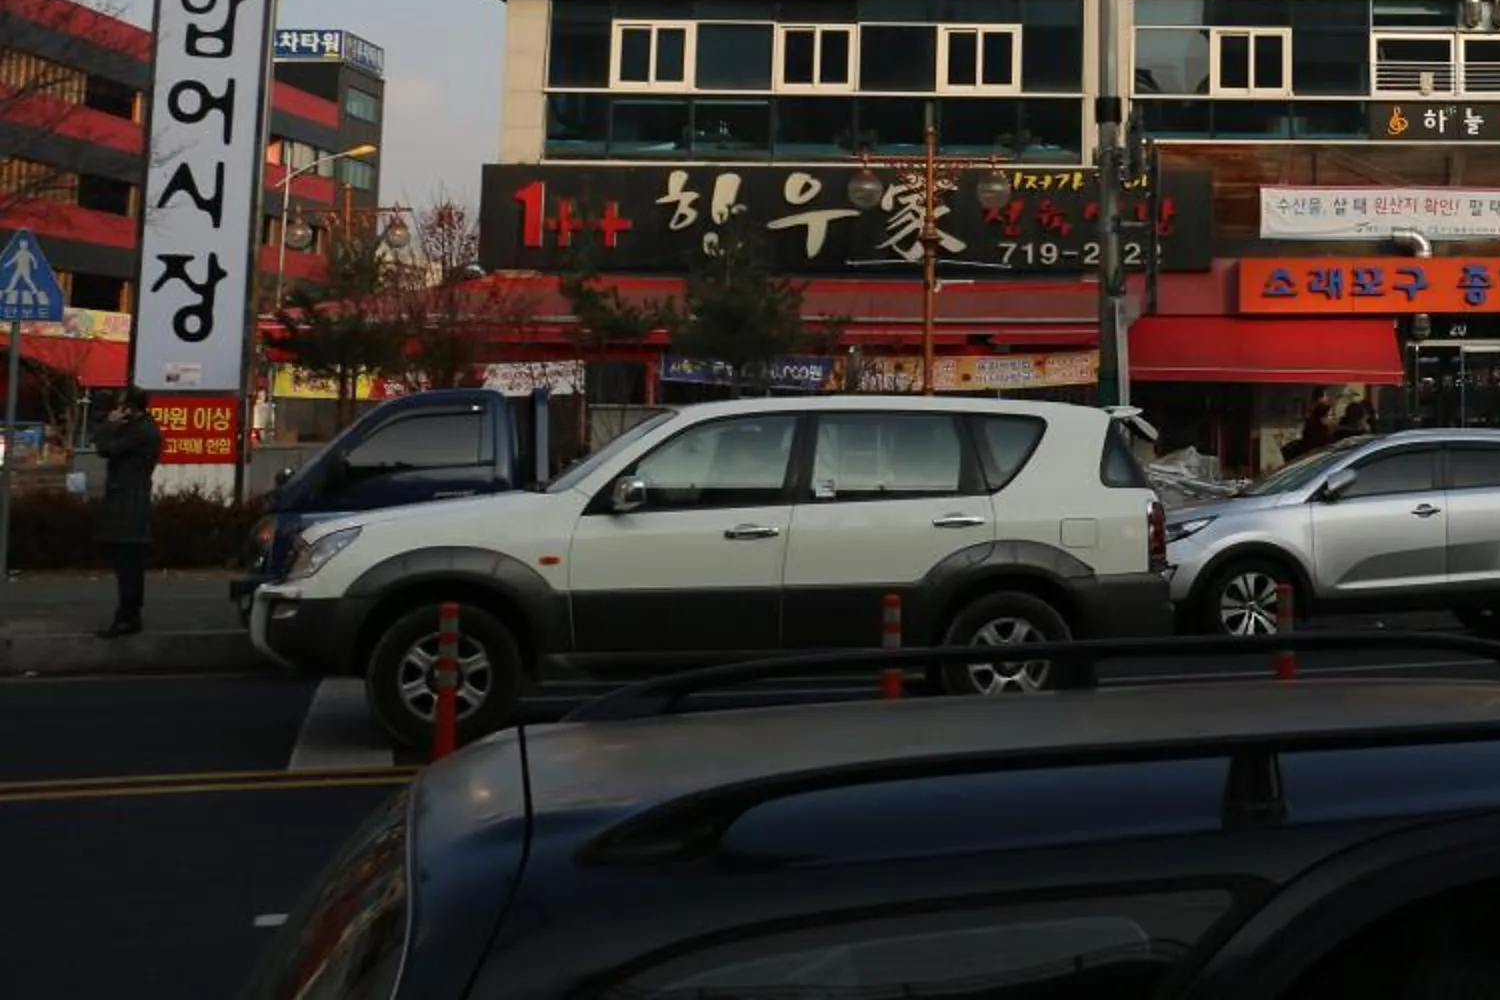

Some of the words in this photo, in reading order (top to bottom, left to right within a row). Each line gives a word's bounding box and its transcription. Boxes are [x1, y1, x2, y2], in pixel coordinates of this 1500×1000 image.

[274, 31, 340, 55] 차타워
[516, 181, 631, 247] 1++
[1262, 266, 1429, 301] 소래포구
[193, 407, 231, 431] 이상
